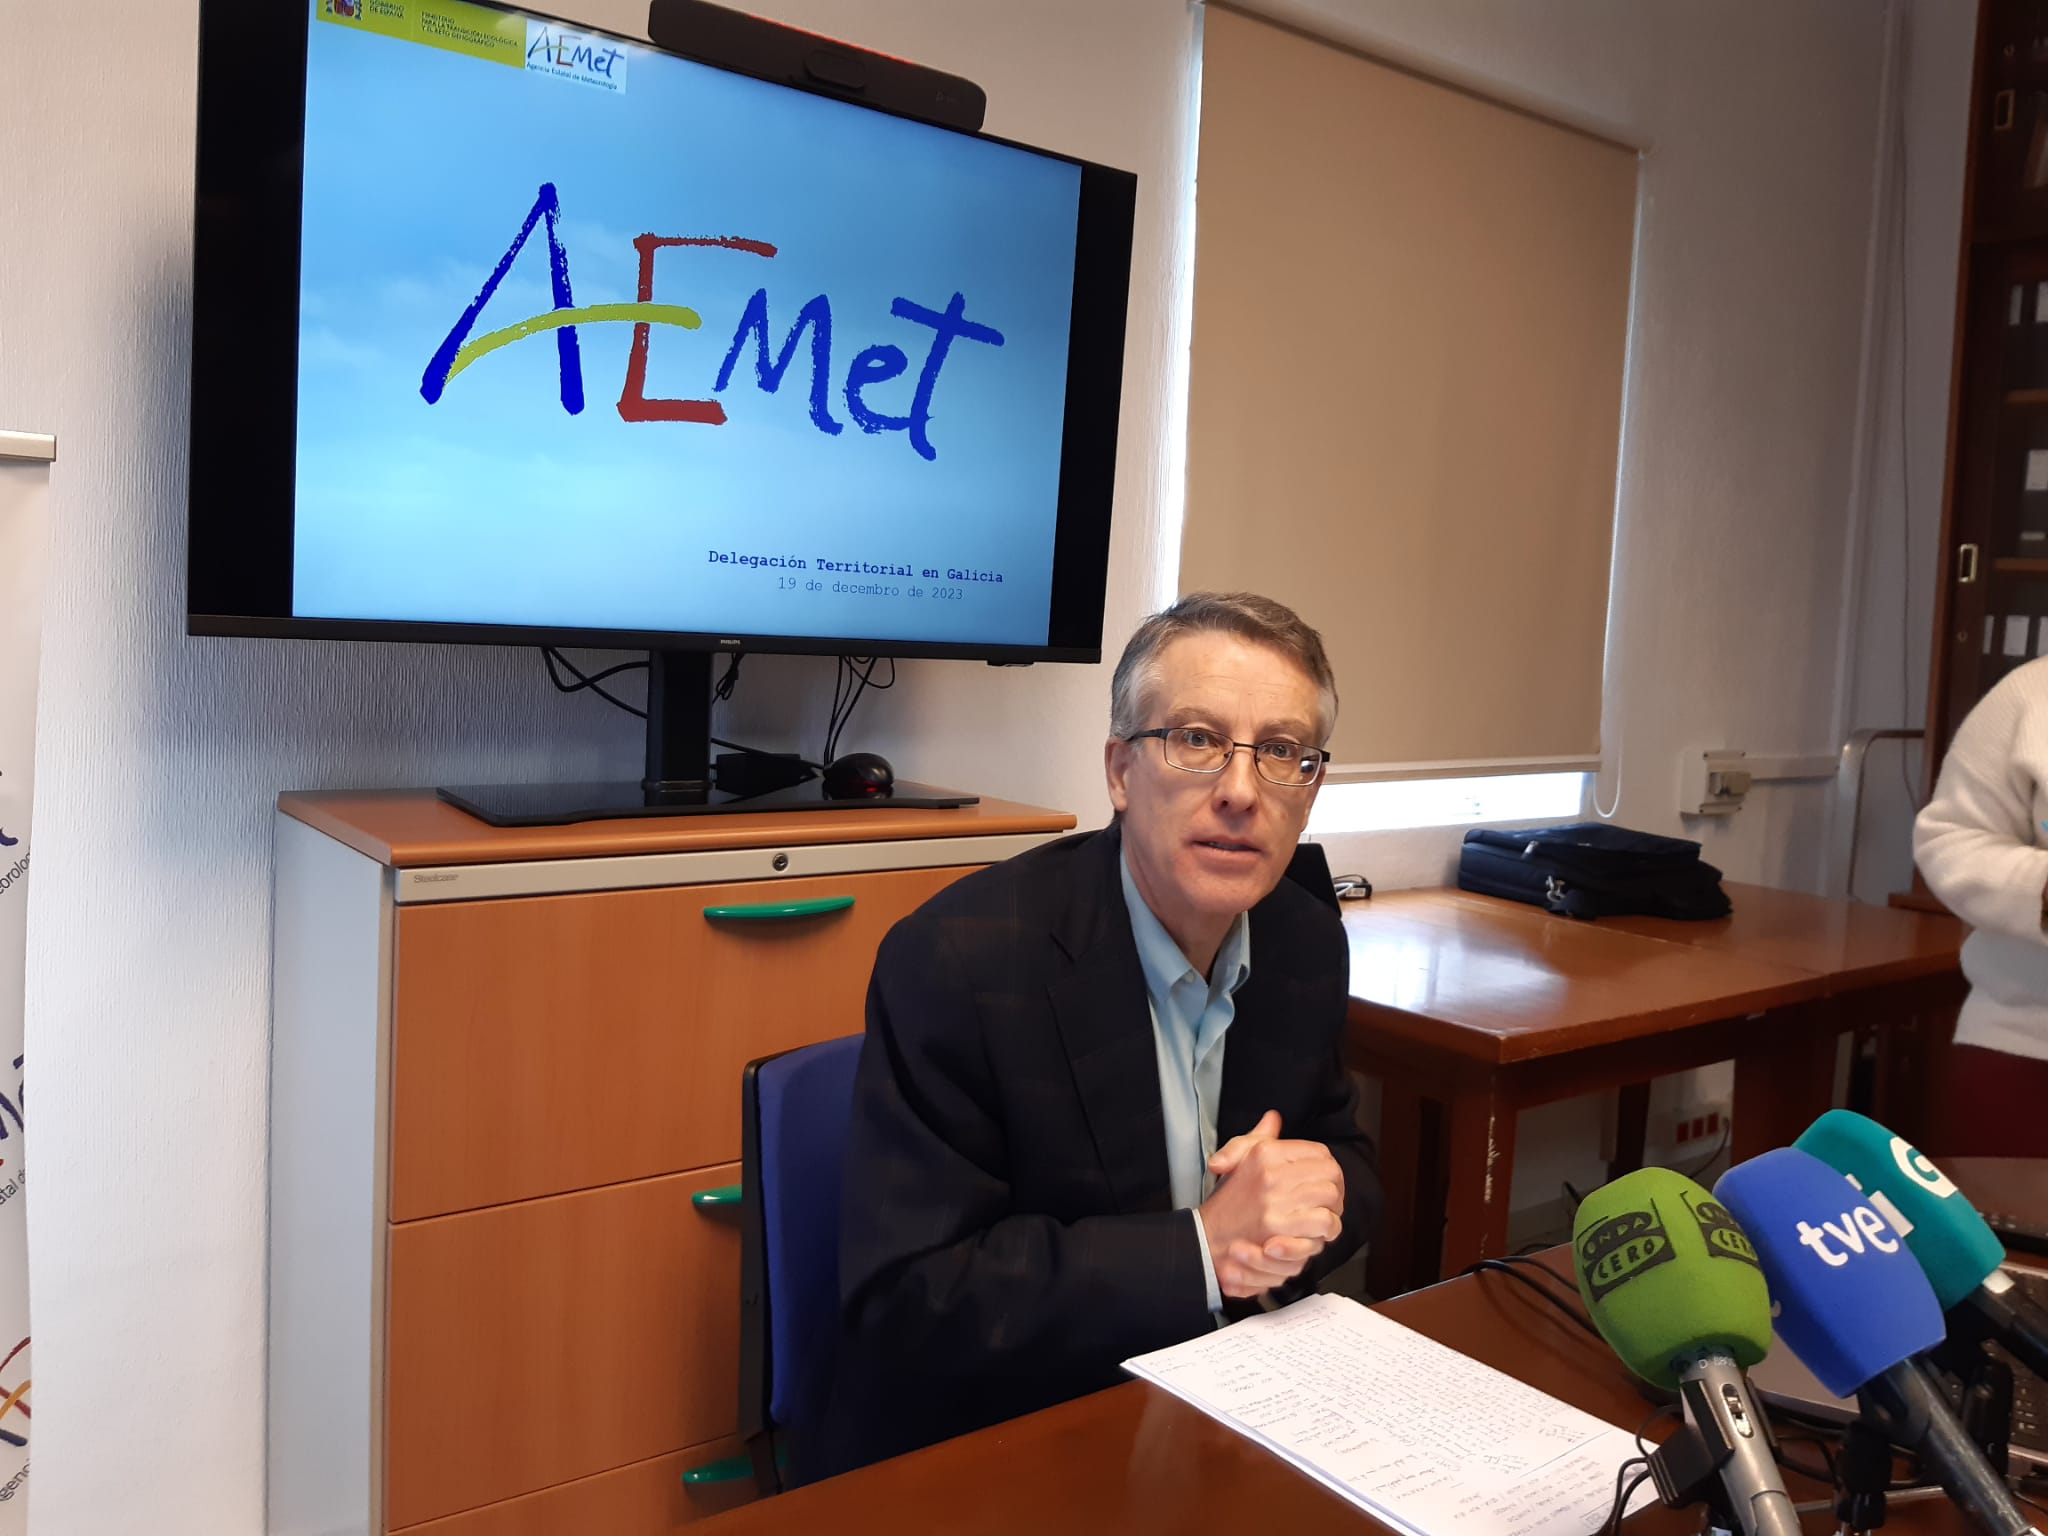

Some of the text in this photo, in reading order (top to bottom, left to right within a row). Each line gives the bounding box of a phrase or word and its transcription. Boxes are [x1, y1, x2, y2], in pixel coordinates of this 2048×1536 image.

[527, 62, 550, 73] Agencia
[552, 67, 571, 78] Estatal
[572, 73, 580, 81] de
[420, 182, 1005, 461] AEMet
[708, 550, 1004, 583] Delegación Territorial en Galicia
[778, 576, 964, 600] 19 de decembro de 2023
[1586, 1216, 1648, 1255] ONDA
[1796, 1206, 1899, 1267] tve
[1598, 1238, 1656, 1279] CERO
